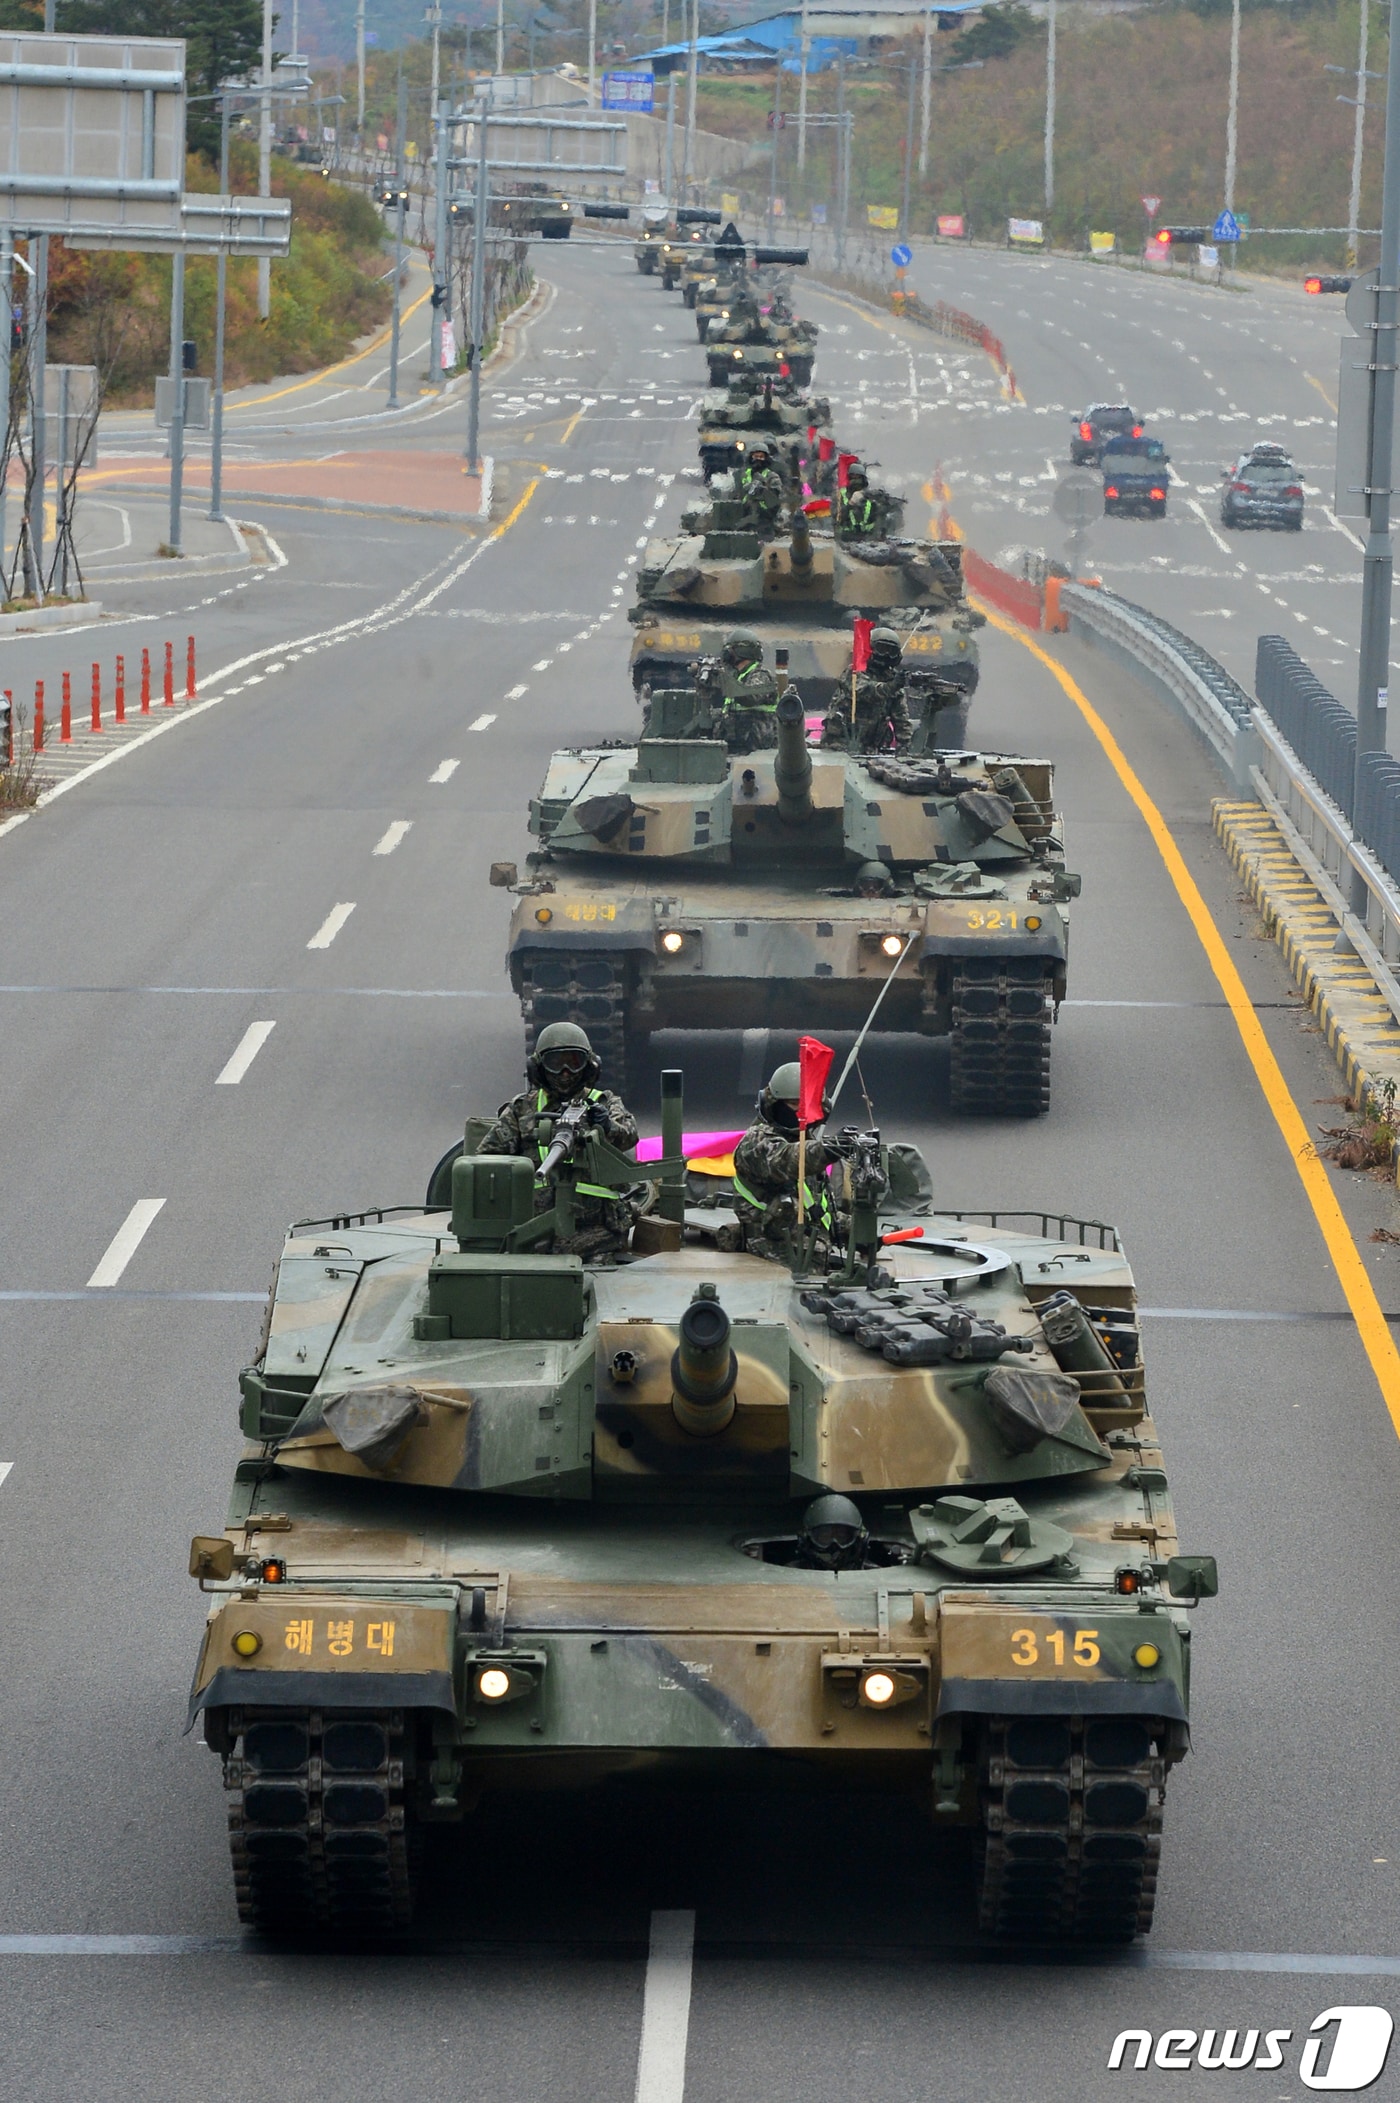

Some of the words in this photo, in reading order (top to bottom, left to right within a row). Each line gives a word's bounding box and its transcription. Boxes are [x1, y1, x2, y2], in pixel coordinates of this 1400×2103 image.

[967, 909, 1017, 929] 321
[285, 1619, 395, 1656] 해병대
[1011, 1629, 1100, 1667] 315
